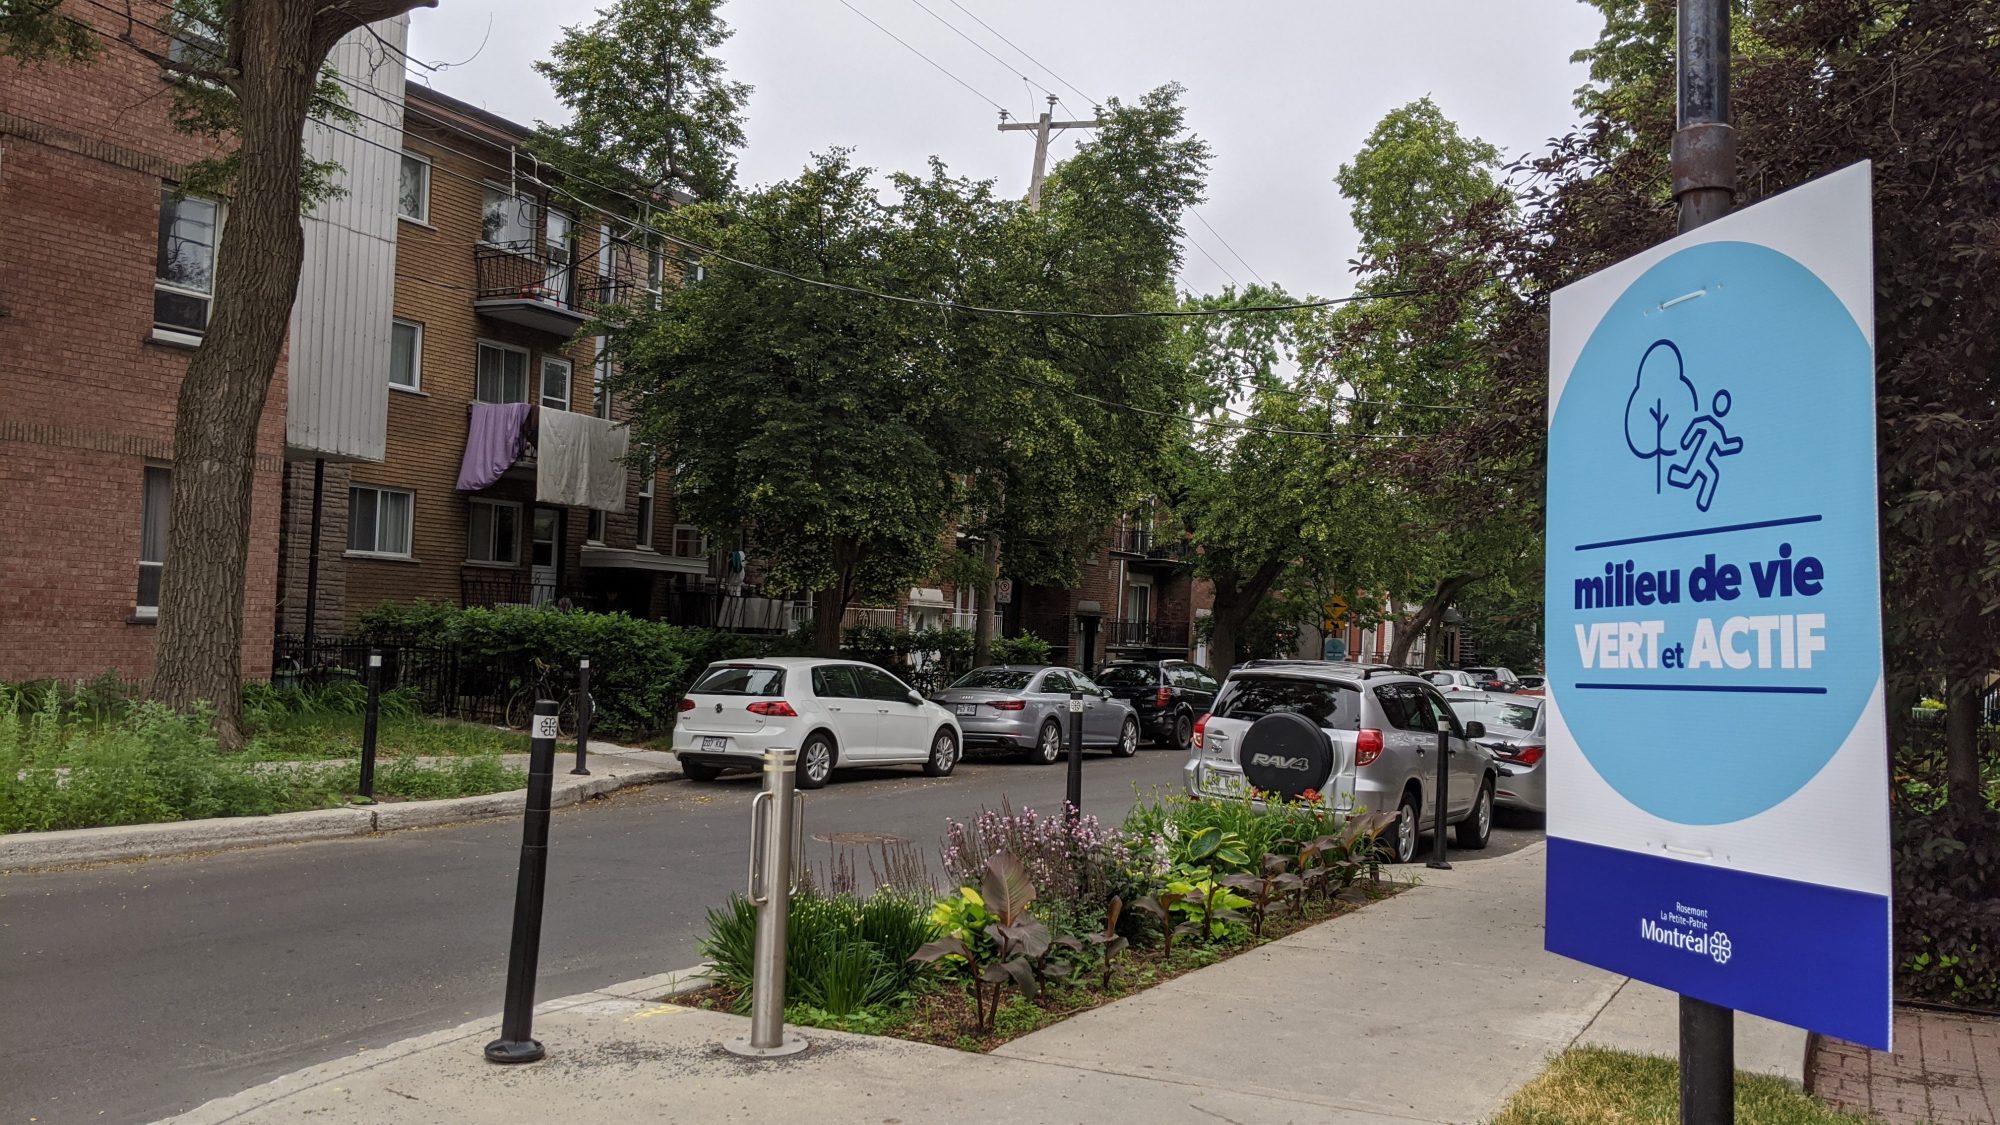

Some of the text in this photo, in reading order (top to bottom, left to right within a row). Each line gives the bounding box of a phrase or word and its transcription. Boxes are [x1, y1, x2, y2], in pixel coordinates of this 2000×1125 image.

[1574, 543, 1825, 610] milieu de vie
[1574, 613, 1825, 670] VERT et ACTIF
[1251, 753, 1309, 772] RAV4
[1660, 910, 1708, 930] La Petite-Patrie
[1676, 901, 1708, 918] Rosemont
[1641, 917, 1708, 955] Montréal
